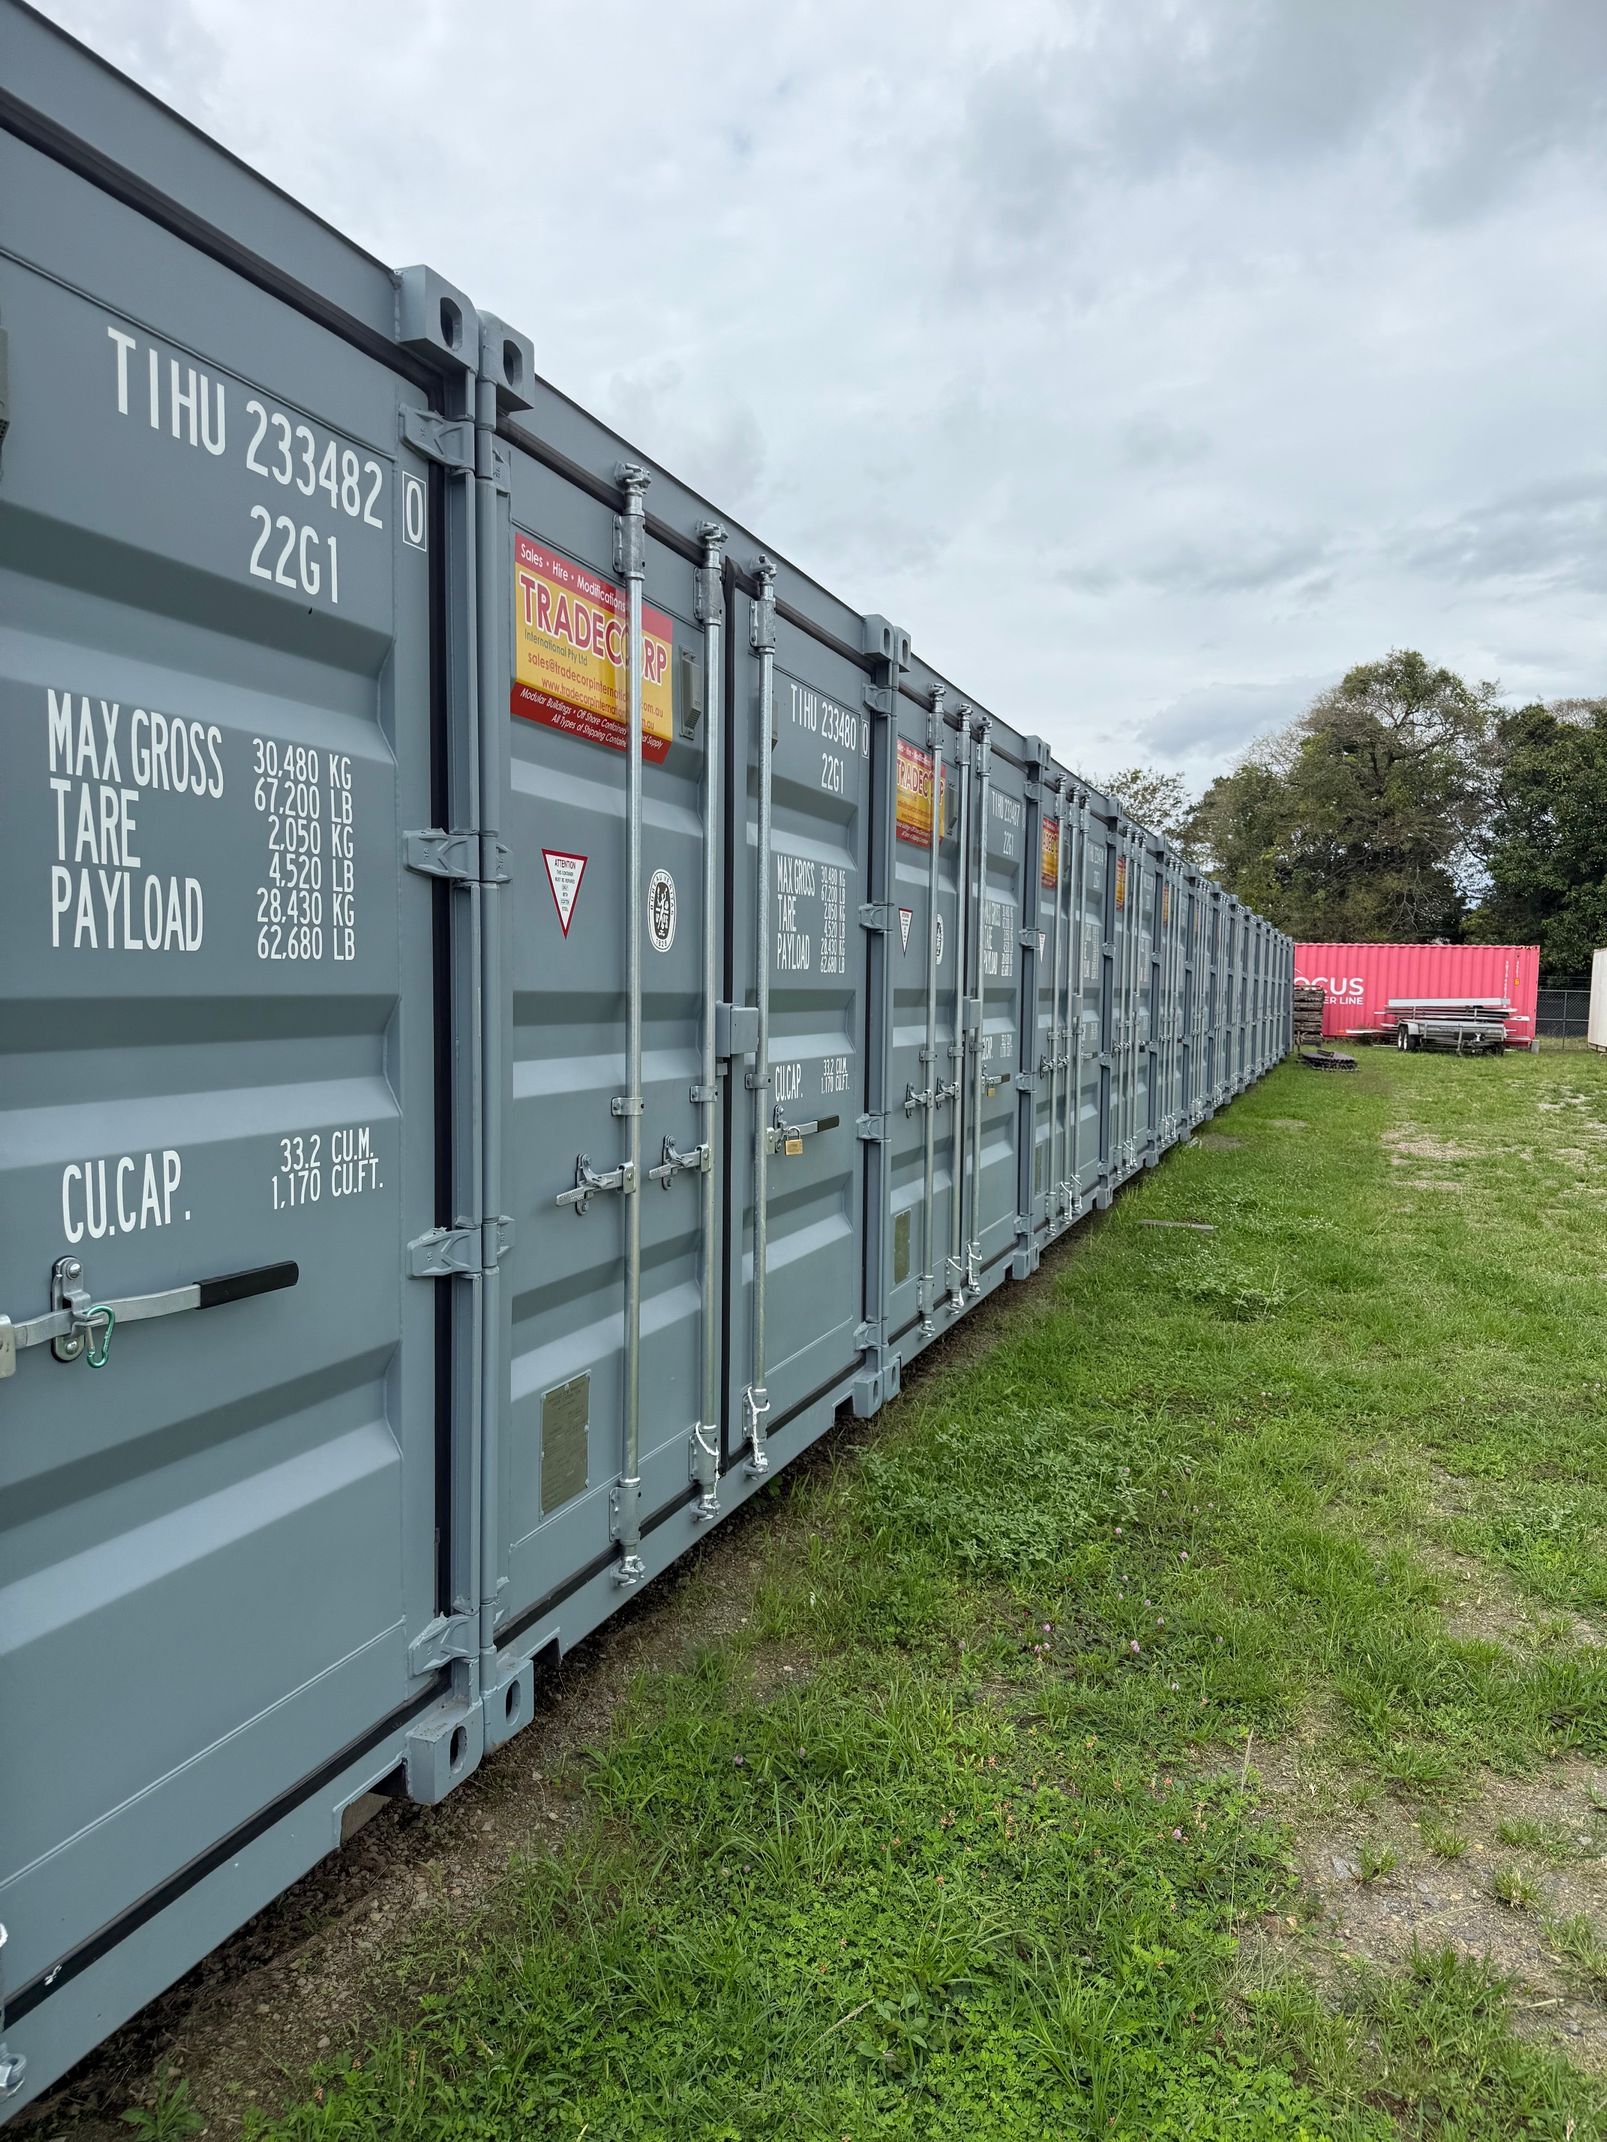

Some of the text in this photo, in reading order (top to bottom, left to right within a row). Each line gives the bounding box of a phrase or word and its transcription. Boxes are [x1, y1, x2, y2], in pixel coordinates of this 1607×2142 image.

[107, 326, 424, 544] TIHU 233482 0
[249, 504, 339, 604] 22G1
[521, 543, 626, 613] Sales Hire Modifications
[519, 570, 668, 686] TRADECRP
[524, 627, 588, 666] International Pty Ltd
[519, 687, 547, 705] Modular
[546, 697, 572, 715] Buildings
[576, 709, 586, 720] Off
[586, 712, 601, 725] Shore
[790, 683, 817, 732] TIHU
[821, 701, 857, 751] 233480
[862, 722, 869, 756] 0
[47, 688, 225, 799] MAX GROSS
[551, 713, 561, 723] All
[559, 715, 576, 731] Types
[583, 722, 605, 742] Shipping
[605, 732, 627, 748] Containe
[252, 738, 352, 790] 30,480 KG
[821, 752, 844, 795] 22G1
[49, 777, 142, 869] TARE
[254, 776, 353, 824] 67,200 LB
[268, 814, 354, 859] 2,050 KG
[269, 851, 354, 893] 4,520 LB
[777, 854, 816, 897] MAX GROSS
[50, 866, 204, 952] PAYLOAD
[256, 887, 355, 927] 28,430 KG
[777, 893, 797, 932] TARE
[257, 924, 355, 961] 62,680 LB
[776, 932, 810, 970] PAYLOAD
[1339, 996, 1364, 1005] LINE
[280, 1126, 374, 1173] 33.2 CU.M.
[271, 1158, 384, 1210] 1,170 CU.FT.
